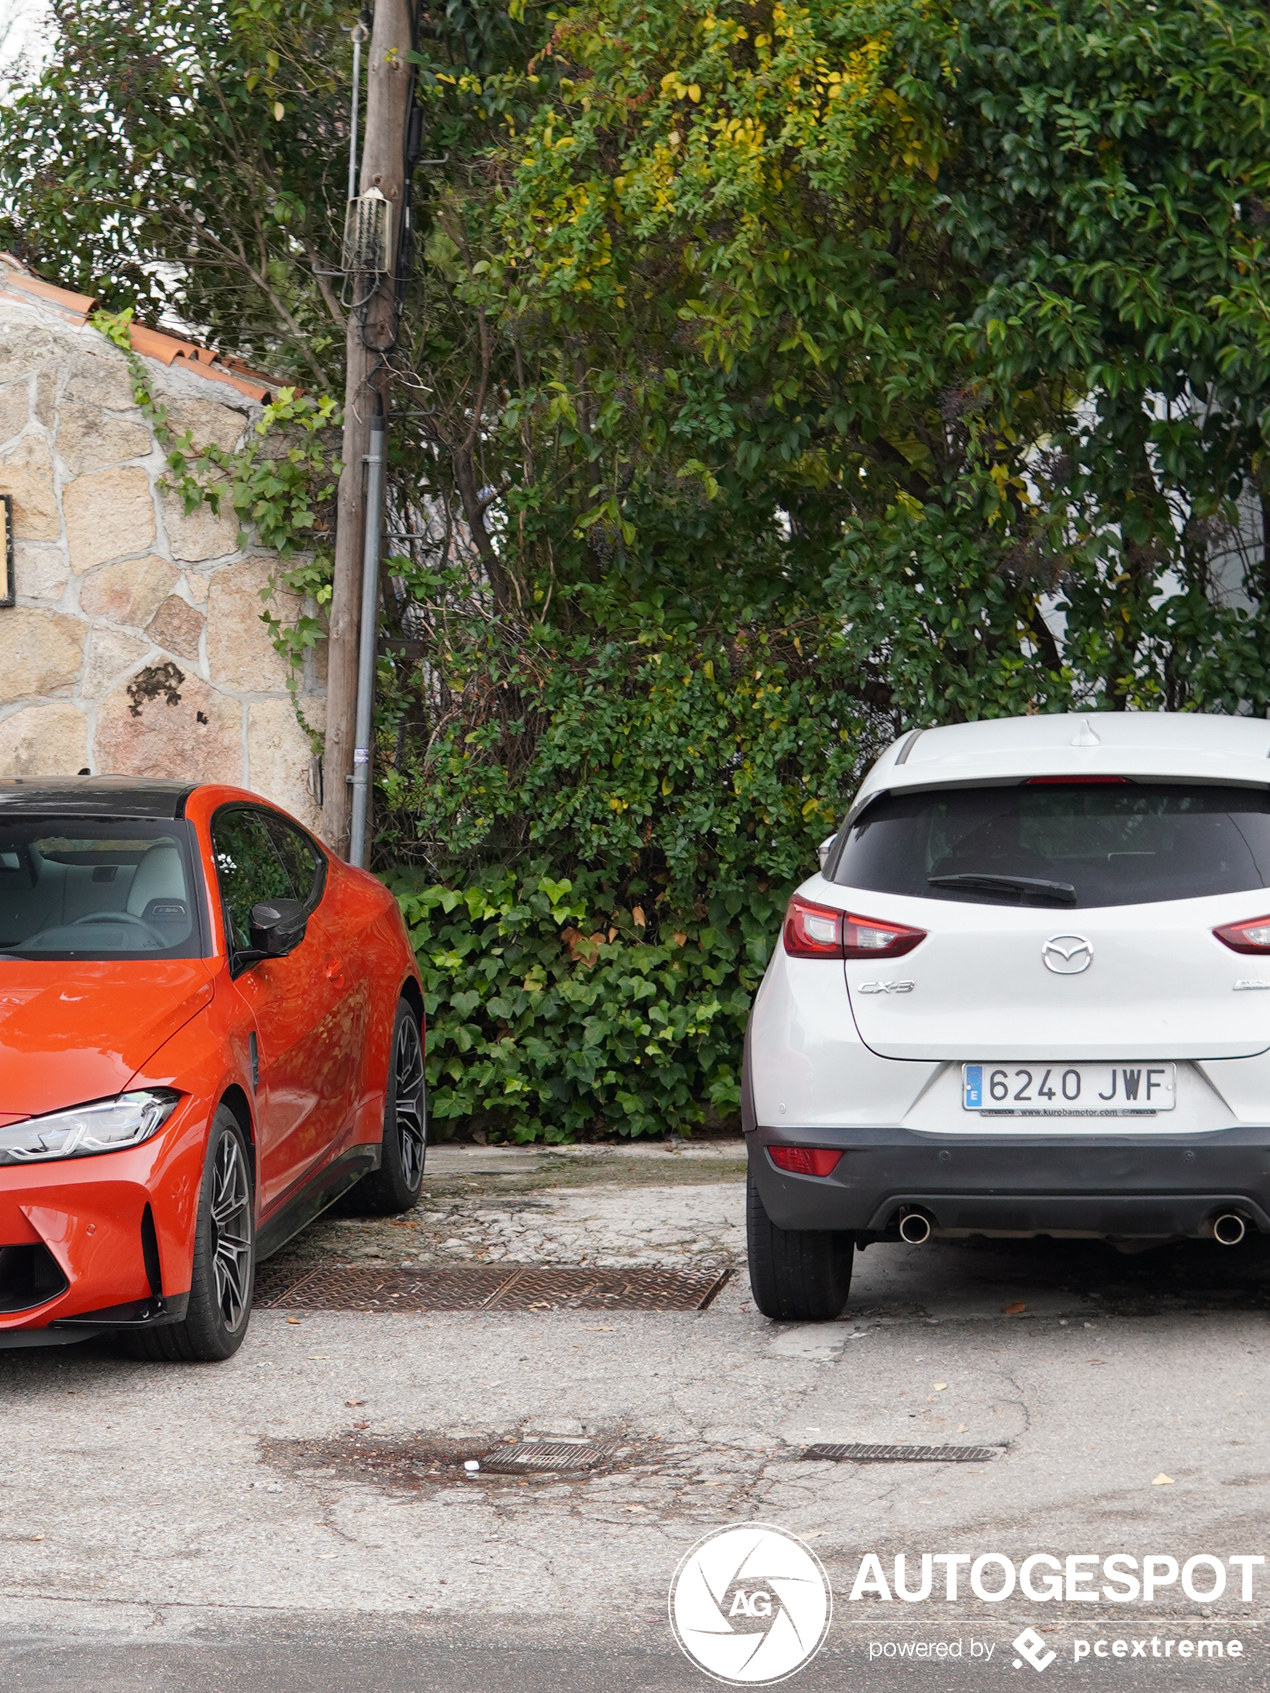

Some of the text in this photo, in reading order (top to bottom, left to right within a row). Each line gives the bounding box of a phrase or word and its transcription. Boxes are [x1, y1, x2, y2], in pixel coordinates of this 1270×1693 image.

[857, 980, 915, 994] CX-3
[970, 1069, 1165, 1101] E 6240 JWF
